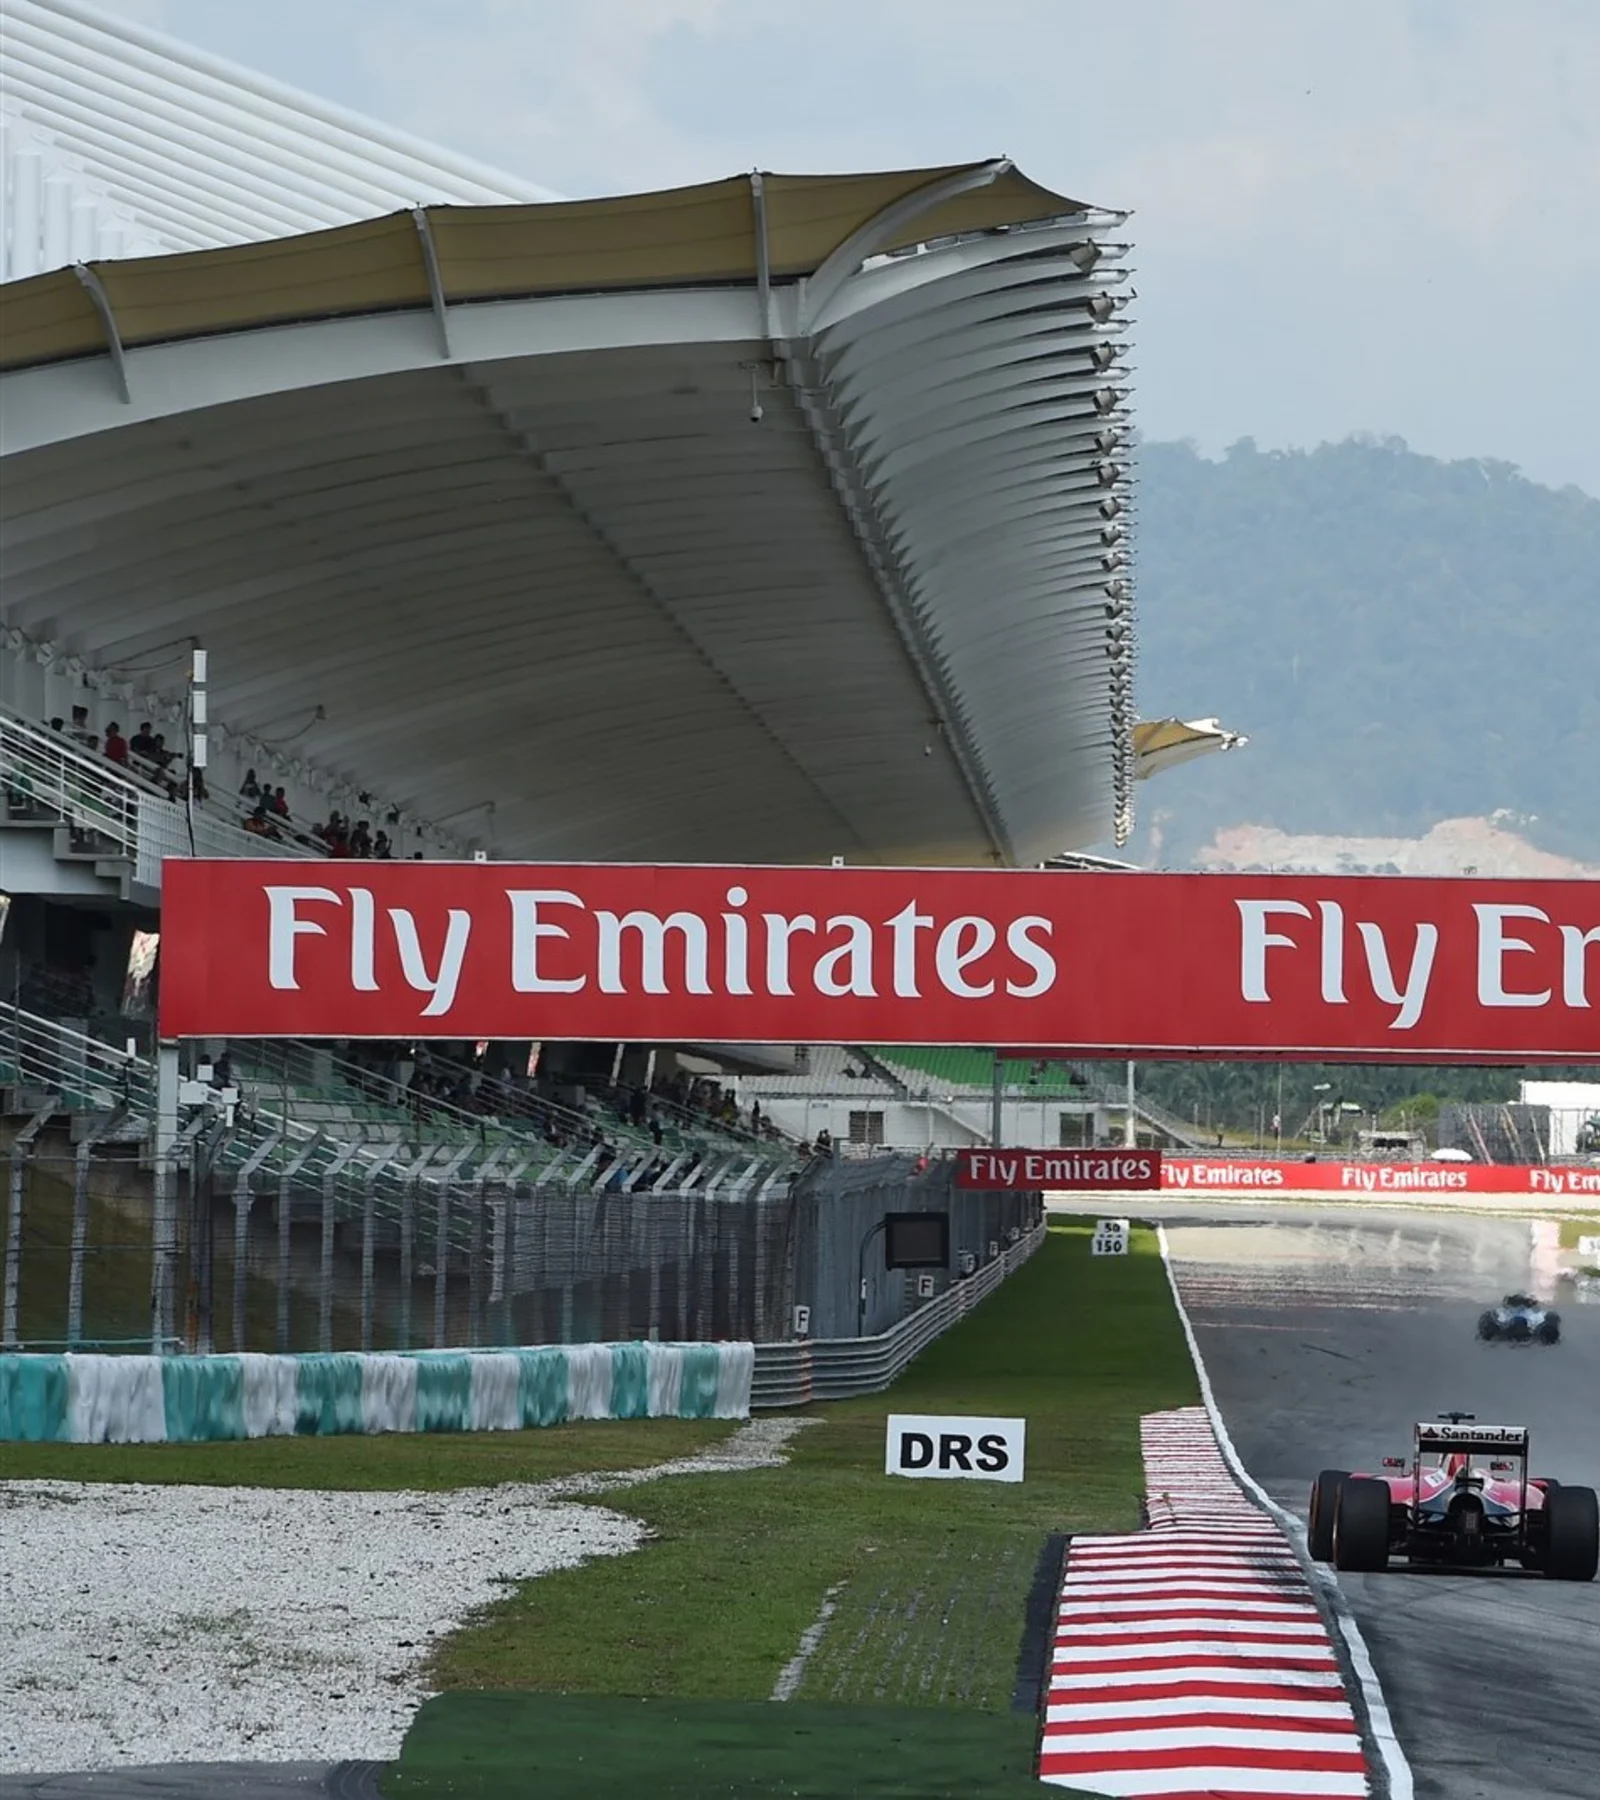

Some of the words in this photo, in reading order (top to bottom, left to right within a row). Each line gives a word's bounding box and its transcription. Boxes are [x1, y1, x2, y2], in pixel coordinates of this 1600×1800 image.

[263, 886, 471, 1018] Fly
[504, 885, 1057, 999] Emirates
[1234, 899, 1439, 1030] Fly
[970, 1154, 1017, 1185] Fly
[1025, 1154, 1151, 1181] Emirates
[1192, 1164, 1284, 1185] Emirates
[1342, 1167, 1376, 1190] Fly
[1380, 1167, 1467, 1188] Emirates
[1530, 1168, 1563, 1193] Fly
[1105, 1222, 1120, 1233] 50
[1096, 1240, 1121, 1253] 150
[921, 1279, 931, 1294] F
[799, 1310, 808, 1329] F
[1441, 1427, 1522, 1442] Santander
[901, 1433, 1008, 1472] DRS
